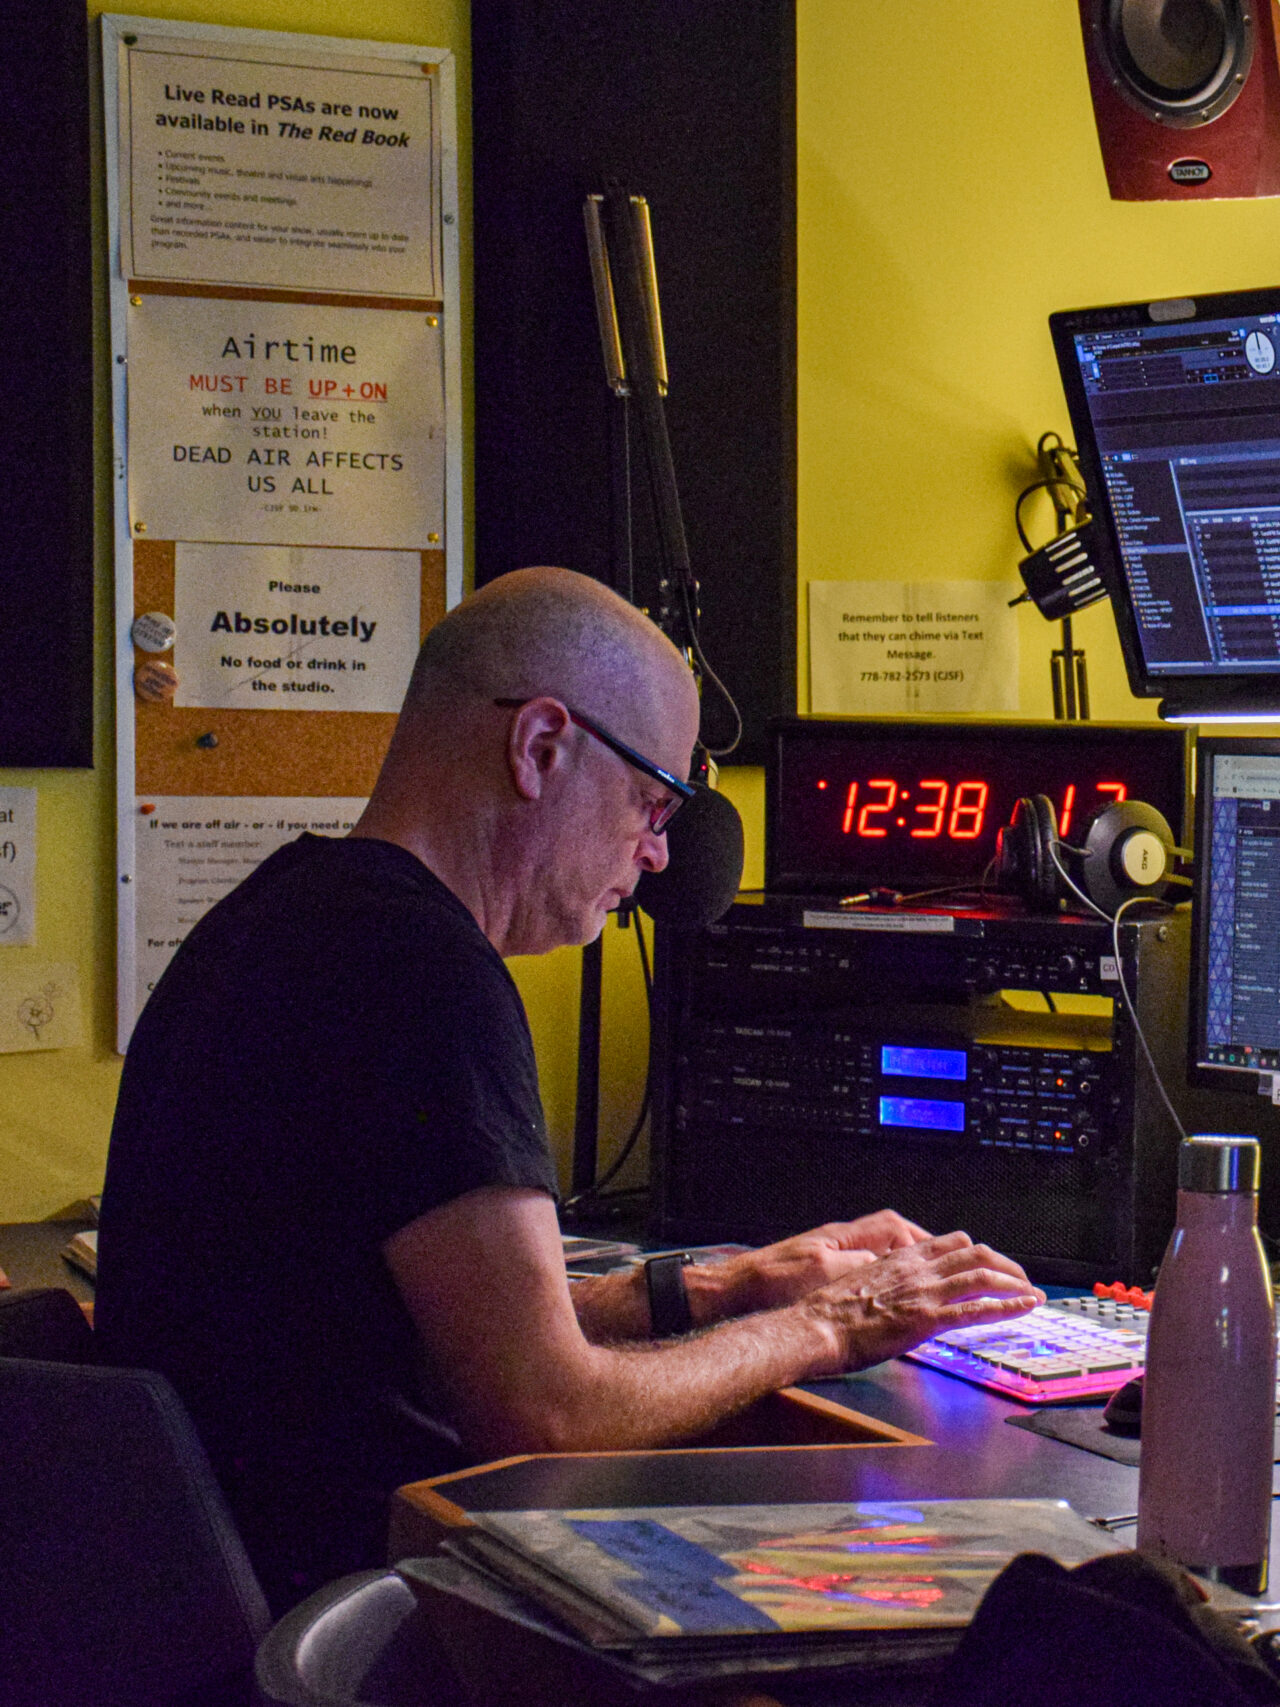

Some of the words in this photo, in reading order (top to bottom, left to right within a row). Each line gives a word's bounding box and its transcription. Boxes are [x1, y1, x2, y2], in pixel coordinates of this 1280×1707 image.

[164, 85, 205, 104] Live
[212, 88, 261, 108] Read
[267, 94, 315, 113] PSAs
[321, 101, 352, 116] are
[358, 104, 399, 121] now
[155, 111, 245, 135] available
[251, 119, 269, 136] in
[278, 122, 313, 140] The
[318, 126, 357, 144] Red
[361, 130, 410, 148] Book
[1174, 166, 1206, 178] TANNOY
[221, 333, 357, 364] Airtime
[189, 374, 248, 393] MUST
[264, 377, 293, 396] BE
[202, 404, 241, 418] when
[250, 406, 282, 421] YOU
[292, 406, 338, 423] leave
[349, 409, 376, 424] the
[252, 424, 329, 440] station!
[173, 445, 232, 464] DEAD
[247, 449, 290, 466] AIR
[306, 451, 404, 472] AFFECTS
[247, 475, 276, 493] US
[291, 477, 334, 495] ALL
[268, 580, 321, 594] Please
[842, 613, 899, 624] Remember
[902, 613, 914, 623] to
[916, 613, 933, 623] tell
[935, 612, 979, 623] listeners
[210, 611, 377, 643] Absolutely
[838, 631, 860, 641] that
[862, 631, 886, 643] they
[888, 633, 907, 641] can
[909, 631, 941, 641] chime
[944, 631, 959, 641] via
[962, 631, 984, 641] Text
[220, 656, 243, 668] No
[247, 656, 282, 670] food
[286, 659, 303, 669] or
[307, 657, 346, 671] drink
[352, 658, 367, 671] in
[860, 671, 931, 682] 778-782-2573
[933, 670, 965, 682] (CJSF)
[252, 679, 277, 692] the
[282, 680, 336, 694] studio.
[843, 779, 989, 839] 12:38
[149, 820, 159, 830] If
[161, 822, 178, 830] we
[181, 821, 201, 830] are
[205, 819, 222, 830] off
[224, 819, 241, 830] air
[252, 821, 265, 830] or
[276, 819, 285, 830] if
[287, 822, 308, 832] you
[310, 819, 338, 830] need
[147, 938, 165, 948] For
[1103, 964, 1116, 973] CD
